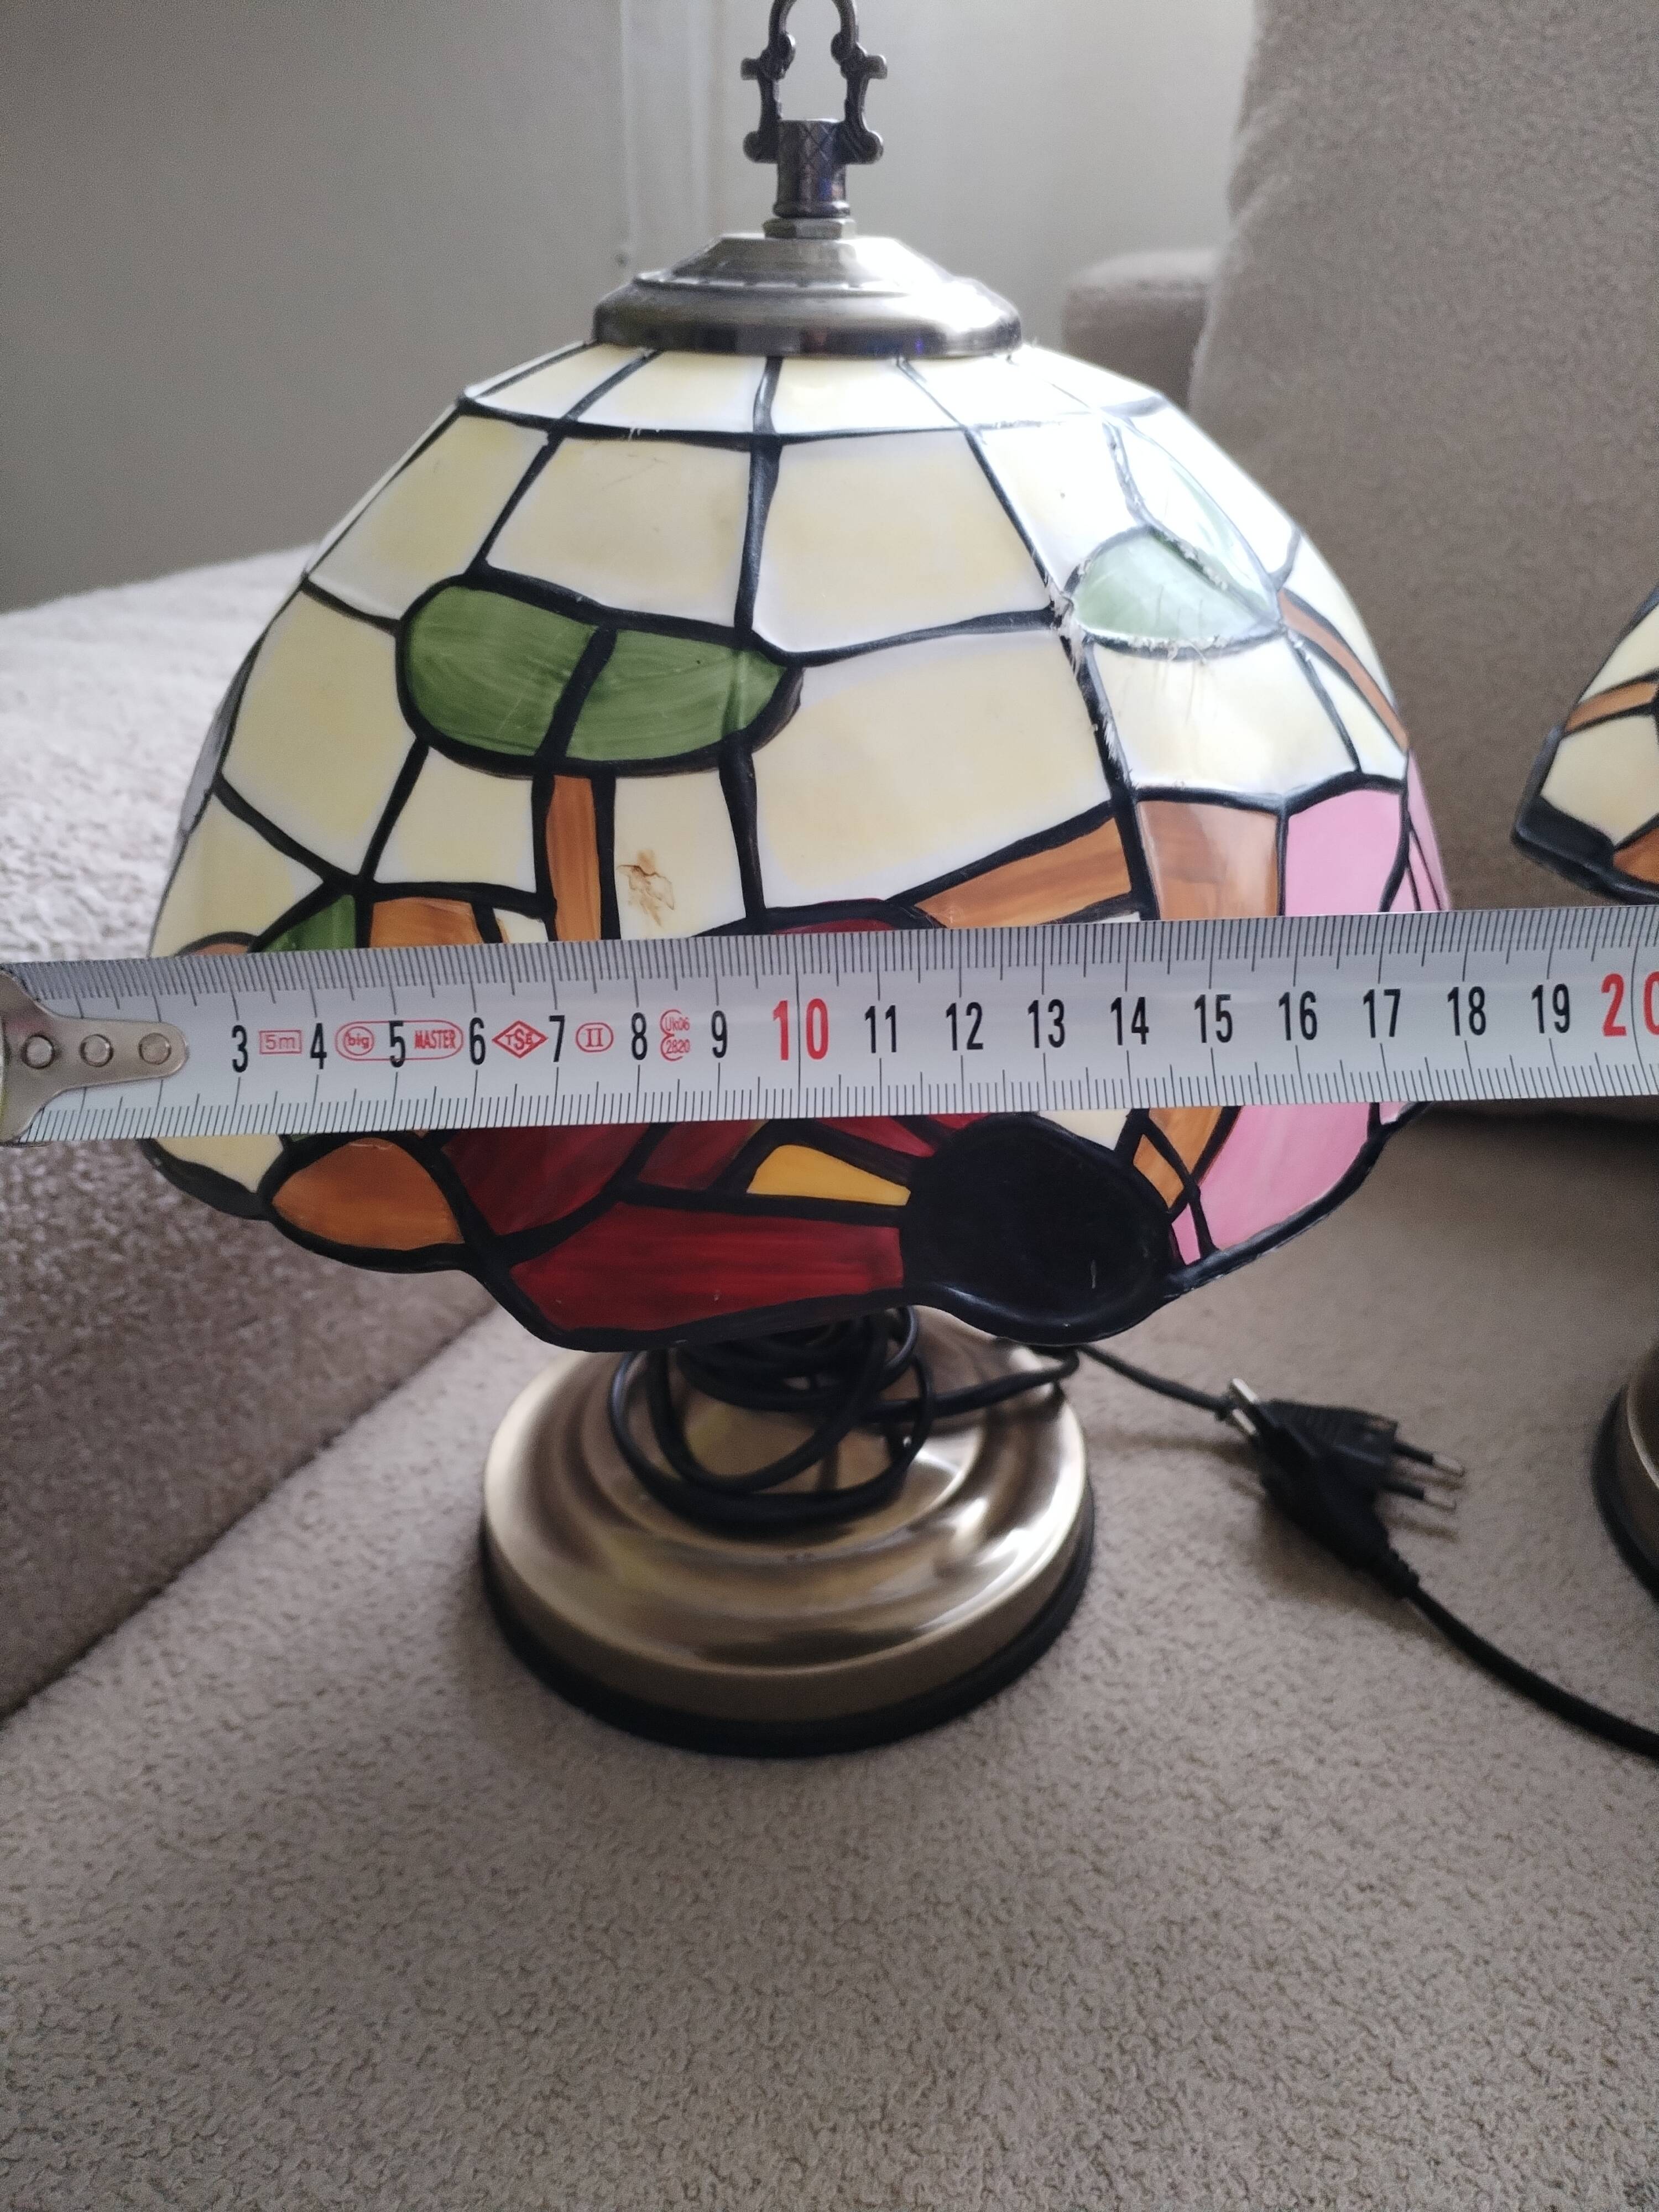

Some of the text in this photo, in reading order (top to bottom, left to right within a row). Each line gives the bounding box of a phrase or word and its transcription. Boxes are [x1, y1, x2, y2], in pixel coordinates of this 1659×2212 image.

[232, 1025, 248, 1072] 3
[311, 1023, 326, 1069] 4
[389, 1021, 405, 1067] 5
[469, 1018, 486, 1065] 6
[549, 1015, 565, 1062] 7
[632, 1013, 647, 1060] 8
[711, 1011, 727, 1058] 9
[773, 998, 829, 1061] 10
[865, 1005, 896, 1053] 11
[946, 1002, 983, 1050] 12
[1028, 999, 1065, 1048] 13
[1111, 997, 1149, 1045] 14
[1194, 994, 1232, 1042] 15
[1279, 991, 1317, 1040] 16
[1363, 989, 1401, 1037] 17
[1447, 986, 1486, 1036] 18
[1532, 984, 1570, 1033] 19
[265, 1034, 295, 1050] 5m
[347, 1029, 456, 1050] big MASTER
[505, 1028, 533, 1050] TSE
